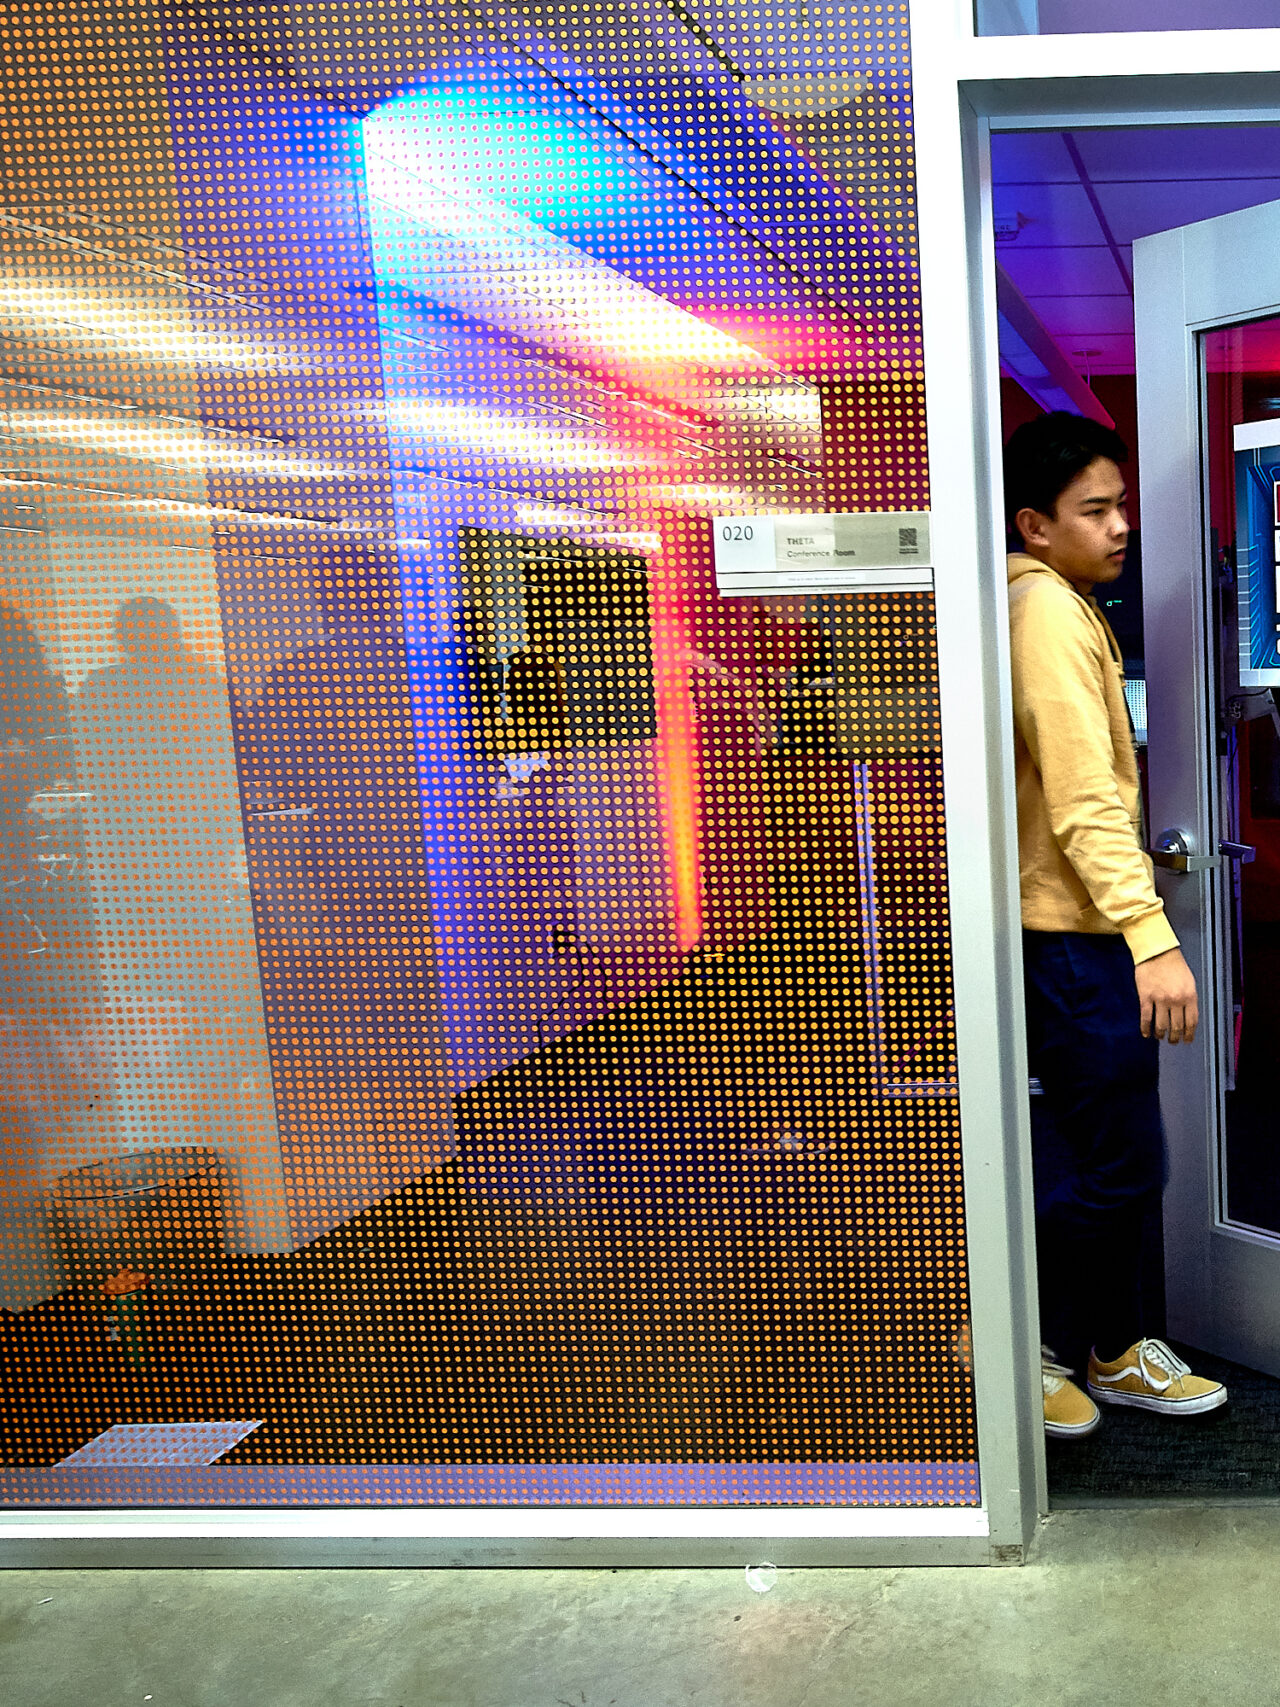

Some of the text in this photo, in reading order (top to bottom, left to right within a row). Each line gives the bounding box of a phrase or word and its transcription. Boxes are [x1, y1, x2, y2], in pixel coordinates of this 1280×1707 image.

[722, 525, 754, 541] 020
[787, 537, 815, 545] THETA
[787, 550, 830, 558] Conference
